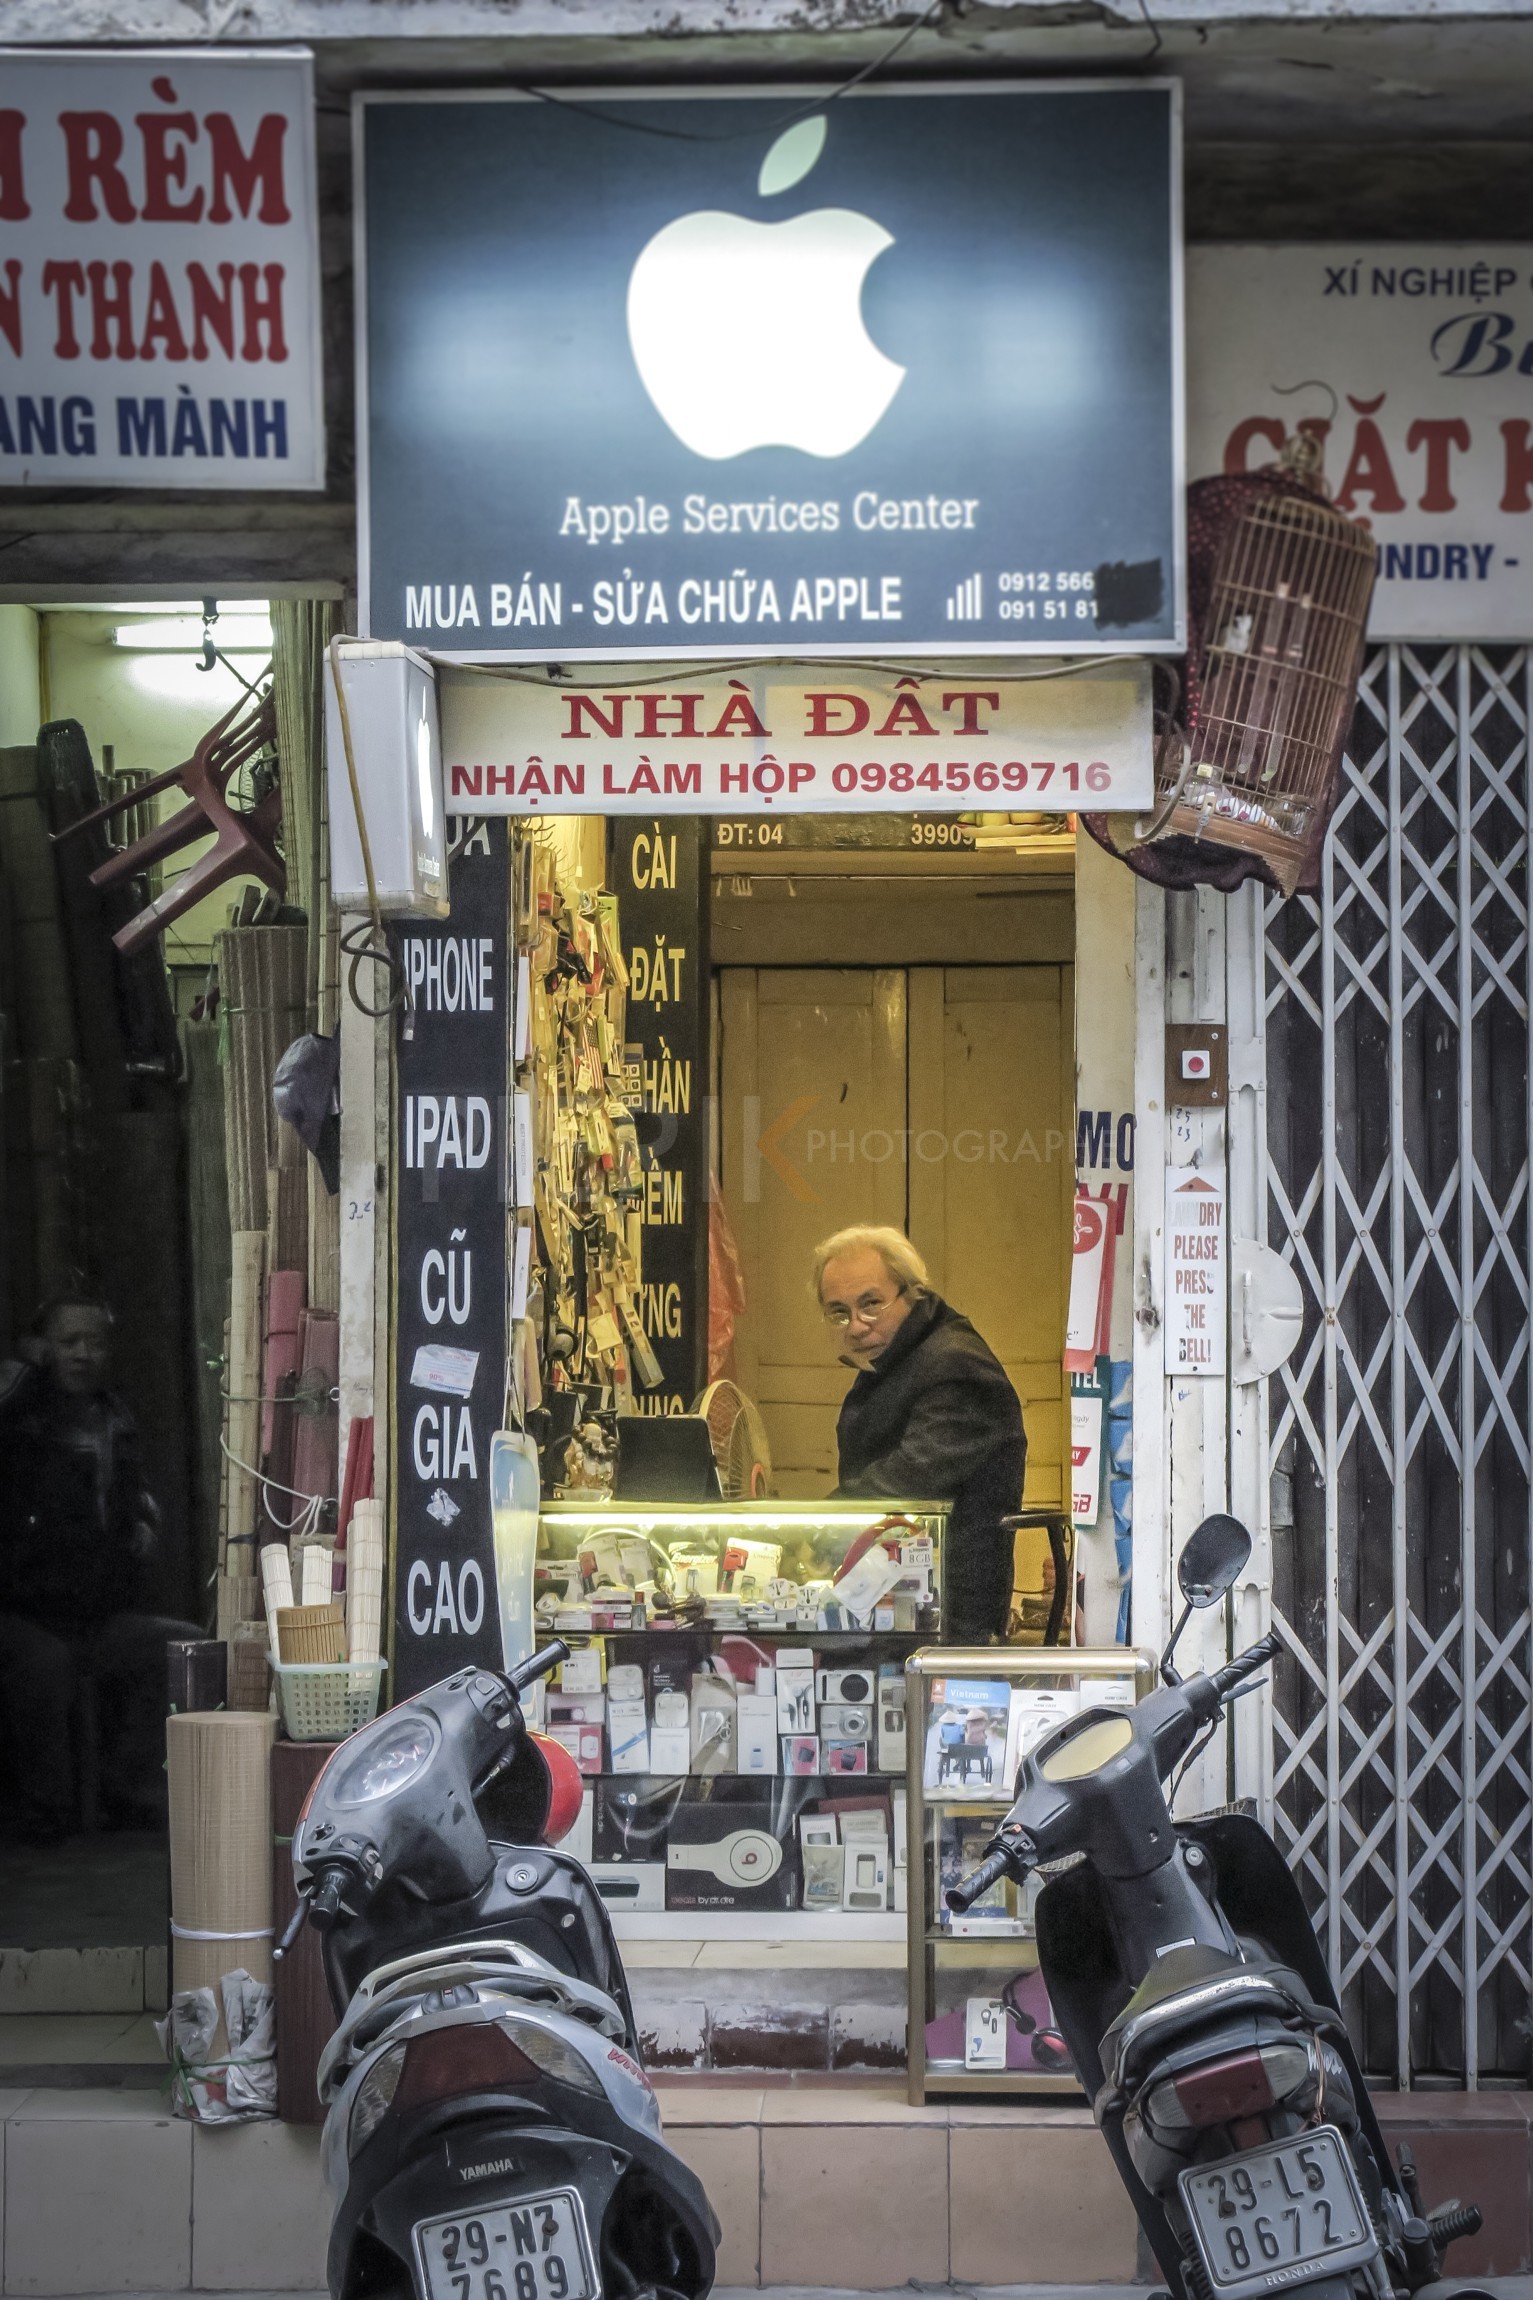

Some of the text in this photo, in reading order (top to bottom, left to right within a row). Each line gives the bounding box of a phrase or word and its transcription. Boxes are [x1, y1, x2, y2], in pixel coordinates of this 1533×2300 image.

[58, 76, 291, 225] RÈM
[1323, 259, 1517, 303] XÍ NGHIỆP
[43, 259, 288, 363] THANH
[116, 384, 288, 459] MÀNH
[559, 491, 979, 545] Apple Services Center
[406, 584, 480, 628] MUA
[491, 571, 561, 626] BÁN
[592, 567, 669, 625] SỬA
[678, 568, 781, 623] CHỮA
[790, 576, 902, 622] APPLE
[999, 571, 1095, 591] 0912 566
[999, 600, 1035, 620] 091
[1044, 600, 1066, 620] 51
[561, 679, 773, 738] NHÀ
[452, 754, 1112, 804] NHẬN LÀM HỘP 0984569716
[632, 822, 676, 889] CÀI
[717, 823, 753, 845] ĐT:
[758, 823, 783, 845] 04
[403, 937, 493, 1012] IPHONE
[630, 934, 685, 1012] ĐẶT
[406, 1095, 491, 1168] IPAD
[420, 1228, 471, 1324] CŨ
[1174, 1235, 1218, 1260] PLEASE
[1184, 1304, 1205, 1329] THE
[1179, 1338, 1211, 1362] BELL!
[407, 1559, 484, 1636] CAO
[950, 1688, 989, 1700] Vietnam
[460, 2158, 514, 2181] YAMAHA
[1208, 2146, 1325, 2219] 29-L5
[442, 2204, 553, 2271] 29-N7
[1226, 2199, 1342, 2269] 8672
[452, 2254, 569, 2300] 7689
[1265, 2261, 1327, 2286] HONDA
